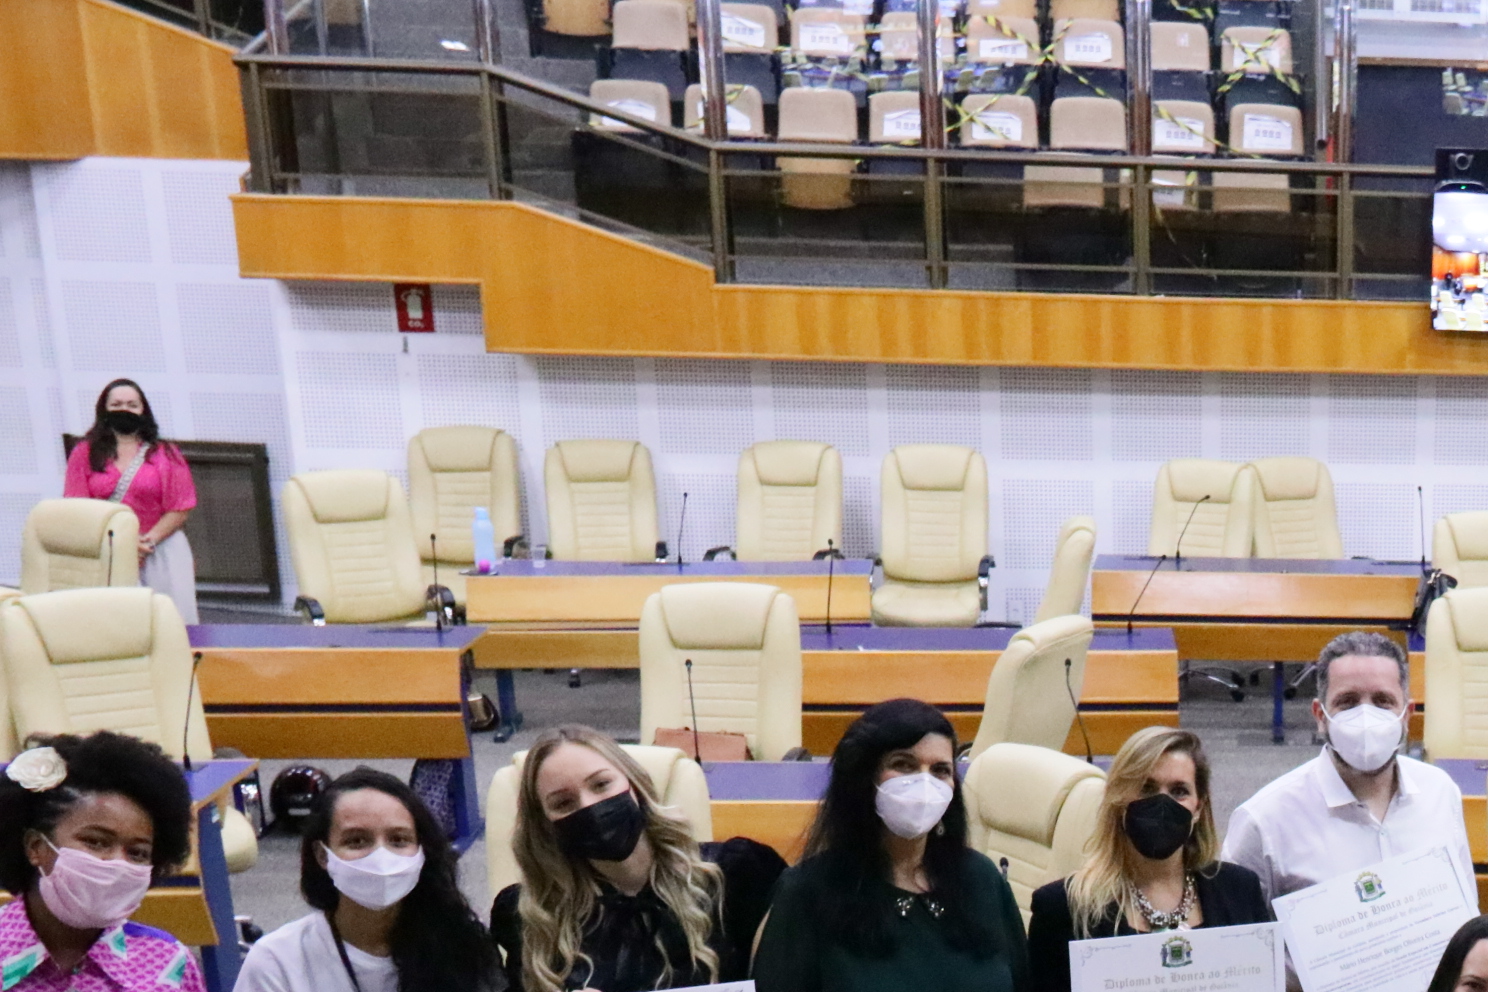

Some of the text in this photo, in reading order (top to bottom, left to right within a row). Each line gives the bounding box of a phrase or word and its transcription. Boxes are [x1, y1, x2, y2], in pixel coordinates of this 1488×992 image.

[1313, 915, 1355, 935] Diploma
[1357, 911, 1367, 919] de
[1370, 899, 1400, 915] Honra
[1403, 895, 1414, 903] ao
[1104, 977, 1151, 989] Diploma
[1154, 975, 1165, 984] de
[1170, 972, 1204, 982] Honra
[1208, 970, 1220, 978] ao
